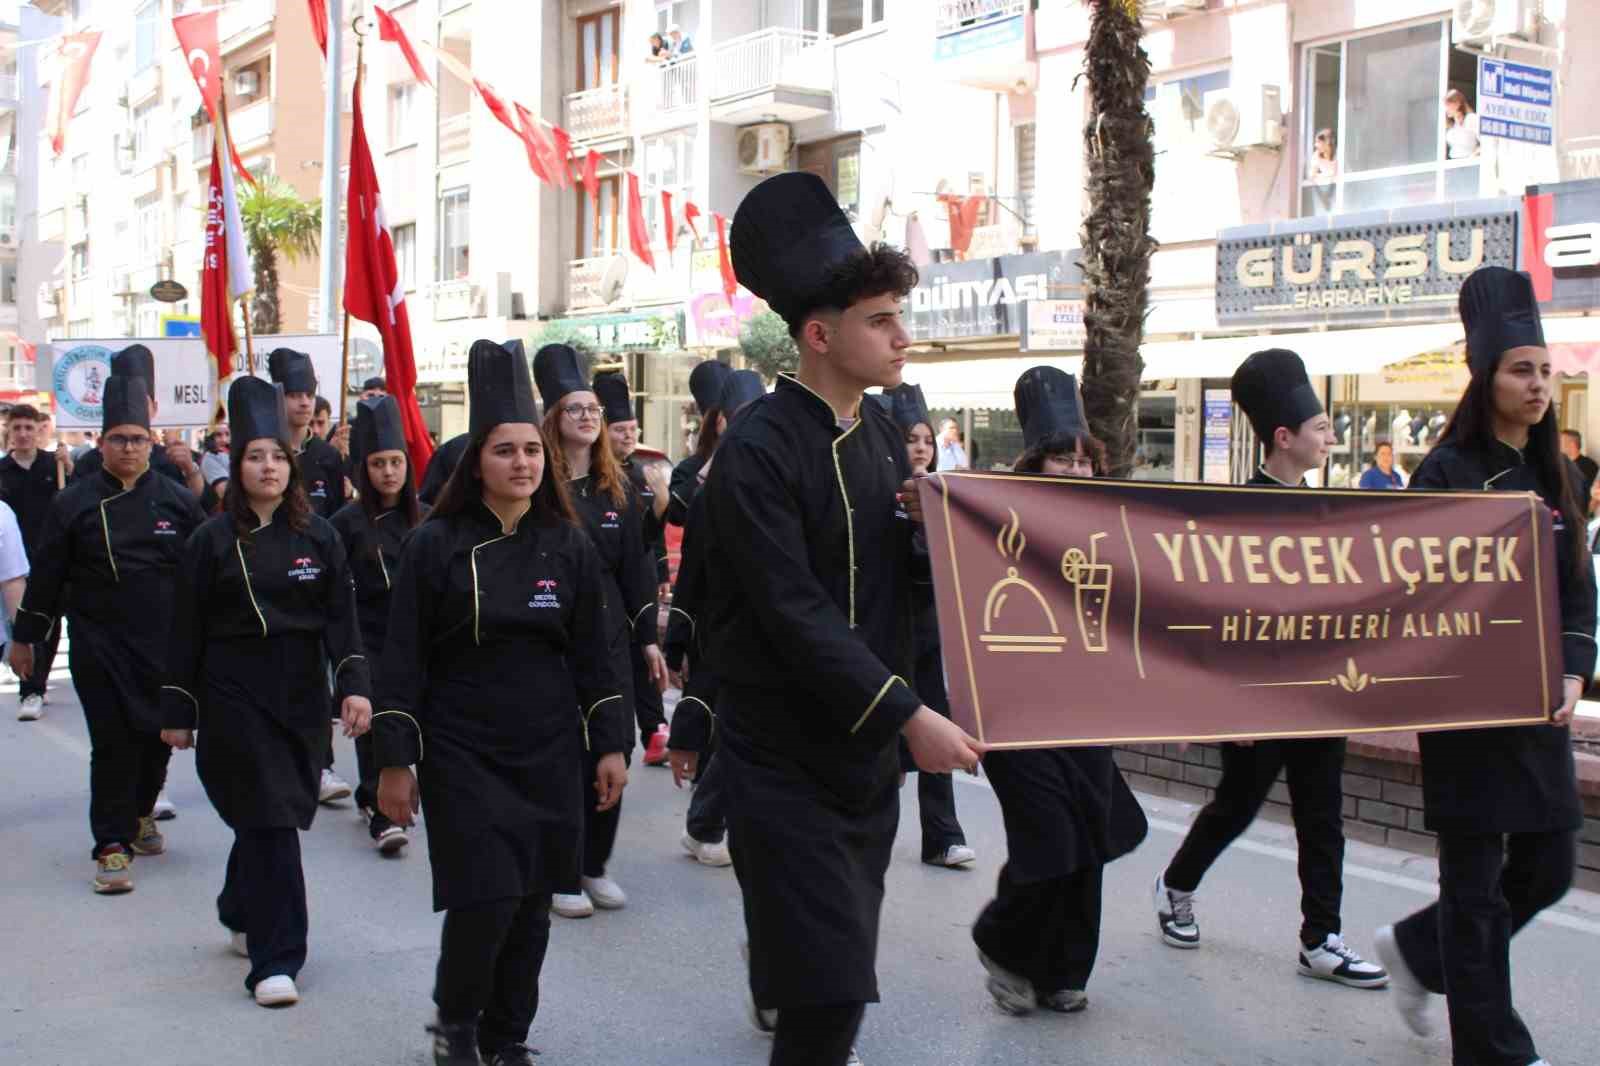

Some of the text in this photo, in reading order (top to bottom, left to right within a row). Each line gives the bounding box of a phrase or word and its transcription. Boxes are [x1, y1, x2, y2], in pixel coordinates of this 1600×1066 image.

[1236, 228, 1484, 288] GÜRSU
[174, 385, 207, 404] MESL
[1153, 520, 1523, 595] YİYECEK İÇECEK
[1221, 608, 1481, 641] HİZMETLERİ ALANI
